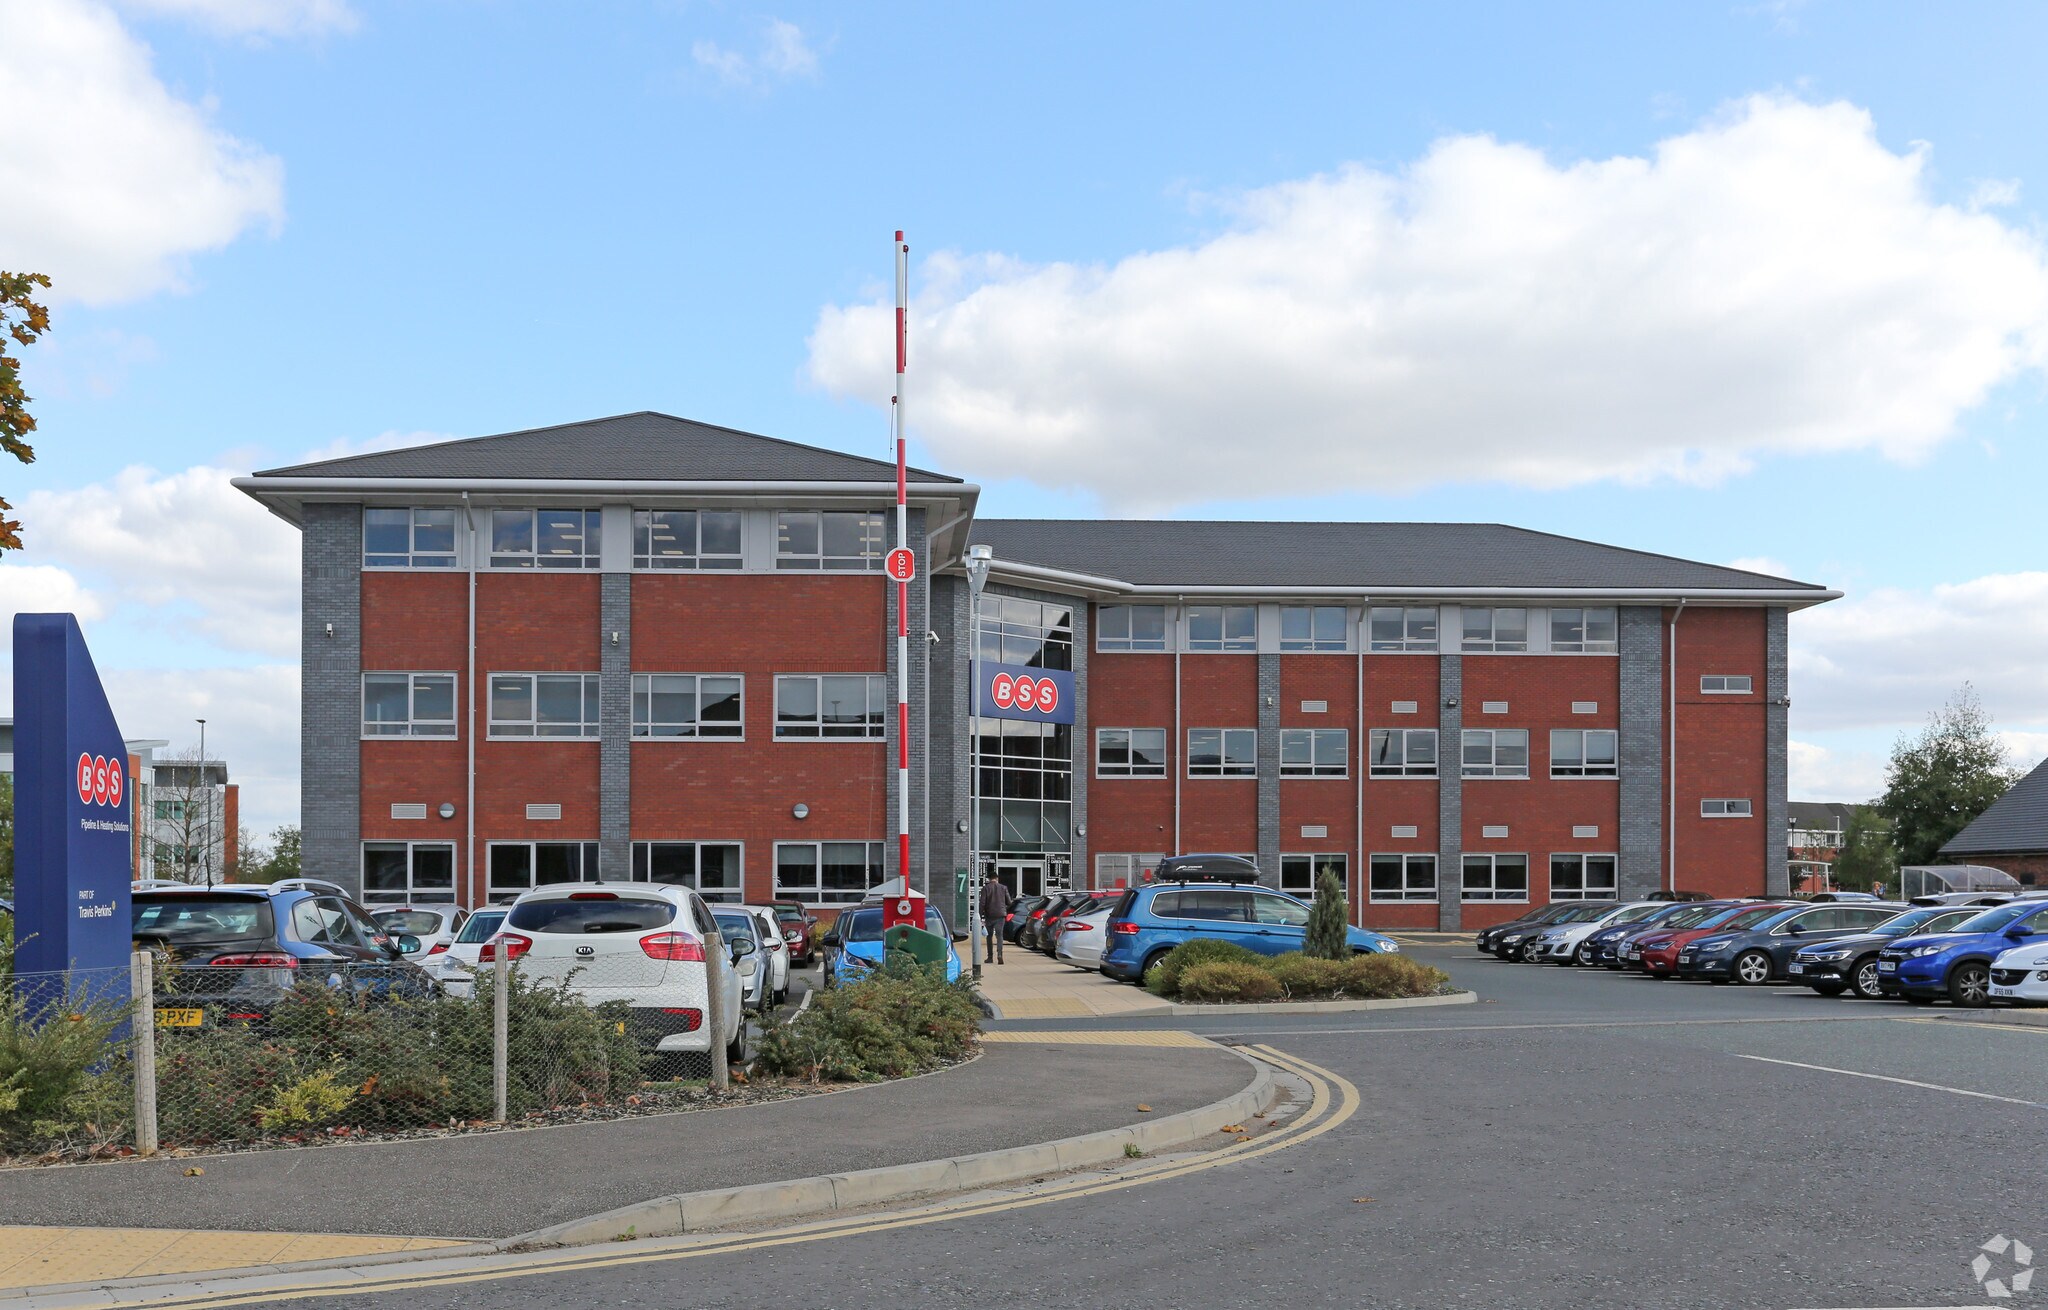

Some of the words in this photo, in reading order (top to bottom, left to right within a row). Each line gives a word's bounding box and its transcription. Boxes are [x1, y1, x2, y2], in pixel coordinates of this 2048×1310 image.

[897, 552, 906, 577] STOP
[996, 680, 1054, 706] BSS
[80, 764, 121, 797] BSS
[81, 818, 97, 831] Pipeline
[100, 820, 114, 833] Heating
[113, 821, 129, 832] Solutions
[957, 873, 967, 893] 7
[78, 890, 89, 899] PART
[88, 890, 95, 899] OF
[78, 905, 94, 918] Travis
[94, 904, 112, 917] Perkins
[166, 1010, 196, 1023] PXF
